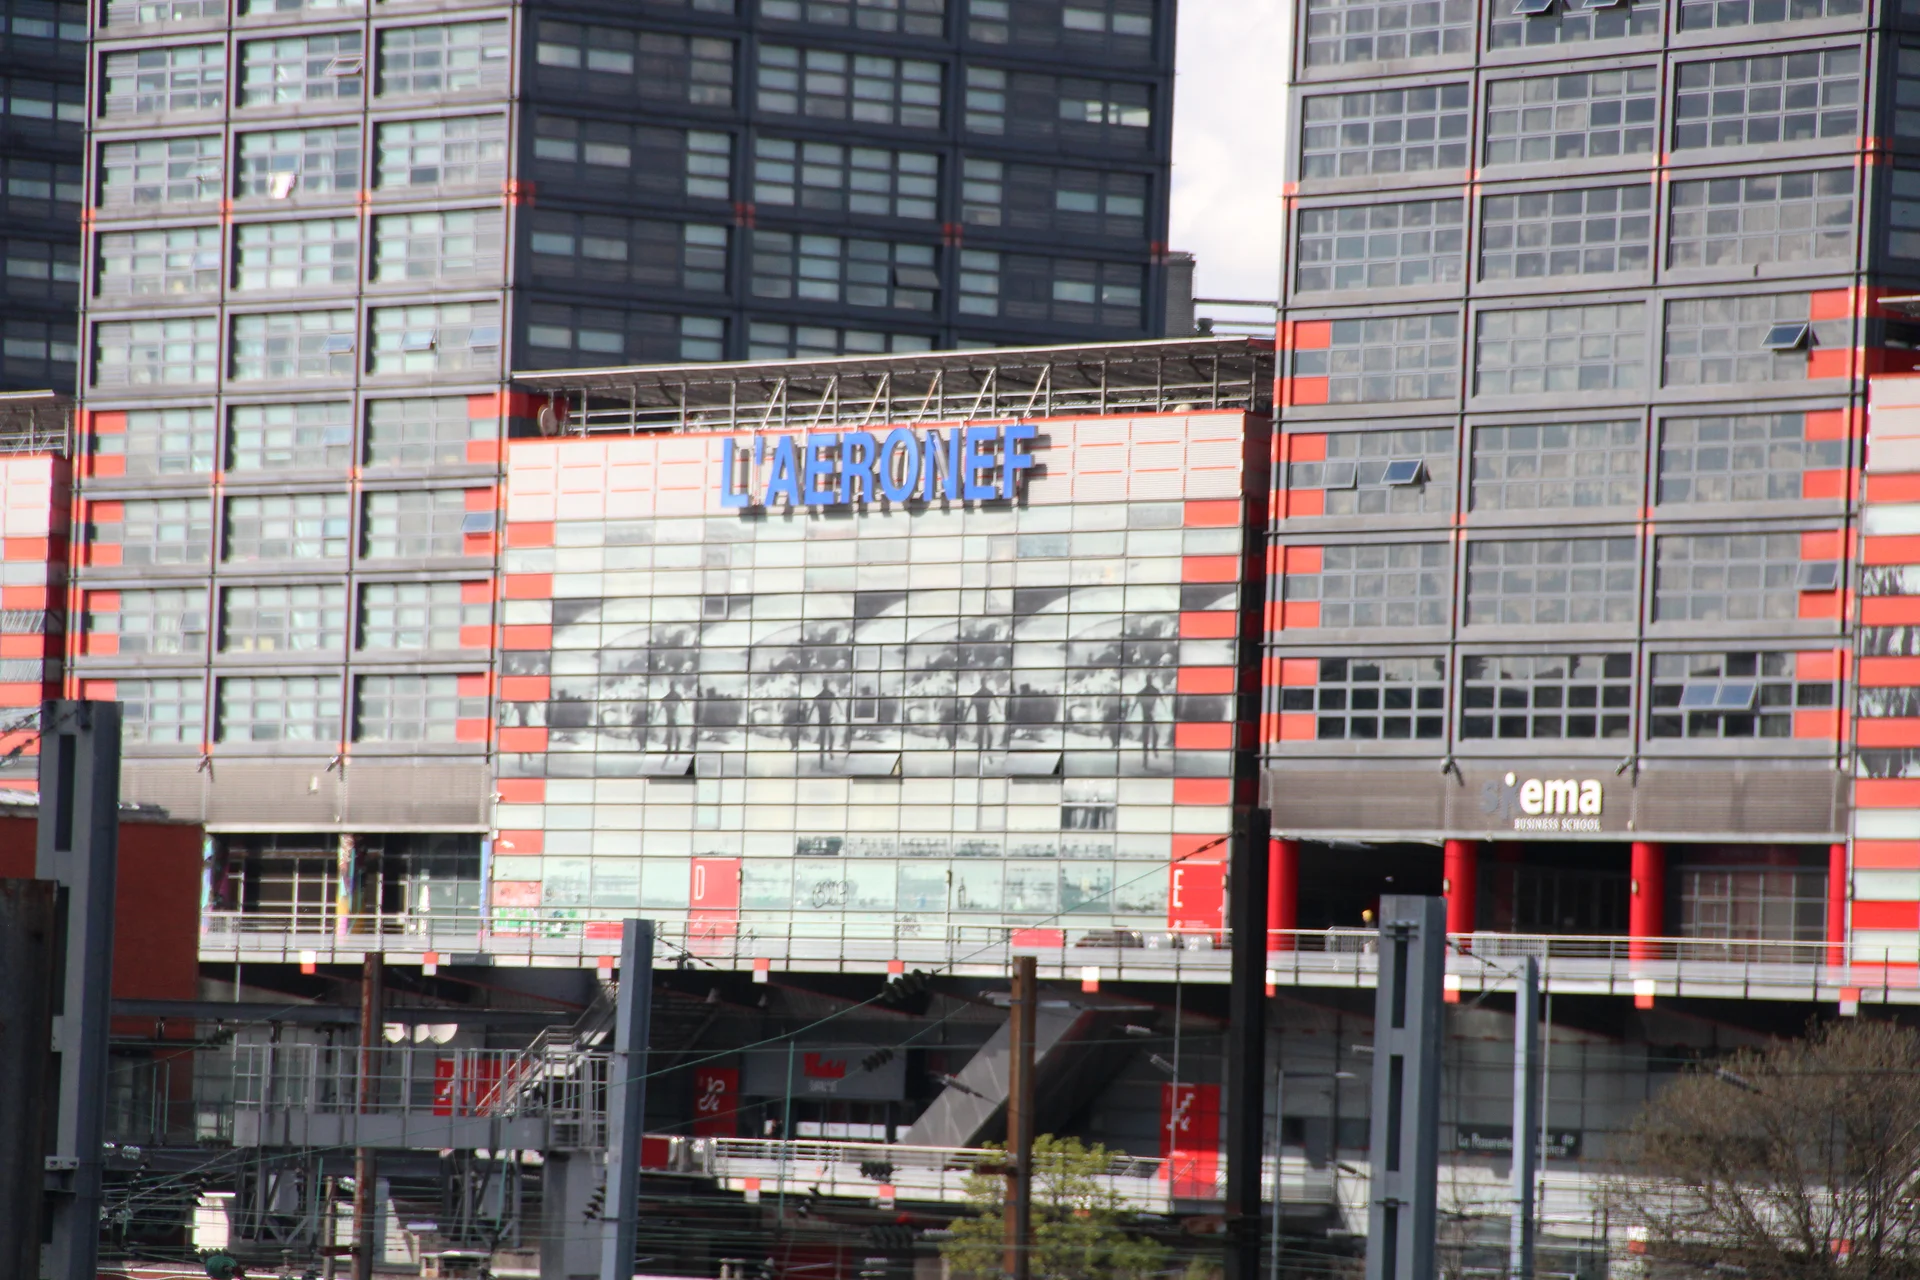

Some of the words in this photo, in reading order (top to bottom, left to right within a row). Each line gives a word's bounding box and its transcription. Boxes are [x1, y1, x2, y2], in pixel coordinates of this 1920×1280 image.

[721, 425, 1038, 508] L'AERONEF
[1514, 819, 1559, 830] BUSINESS
[1561, 819, 1601, 831] SCHOOL
